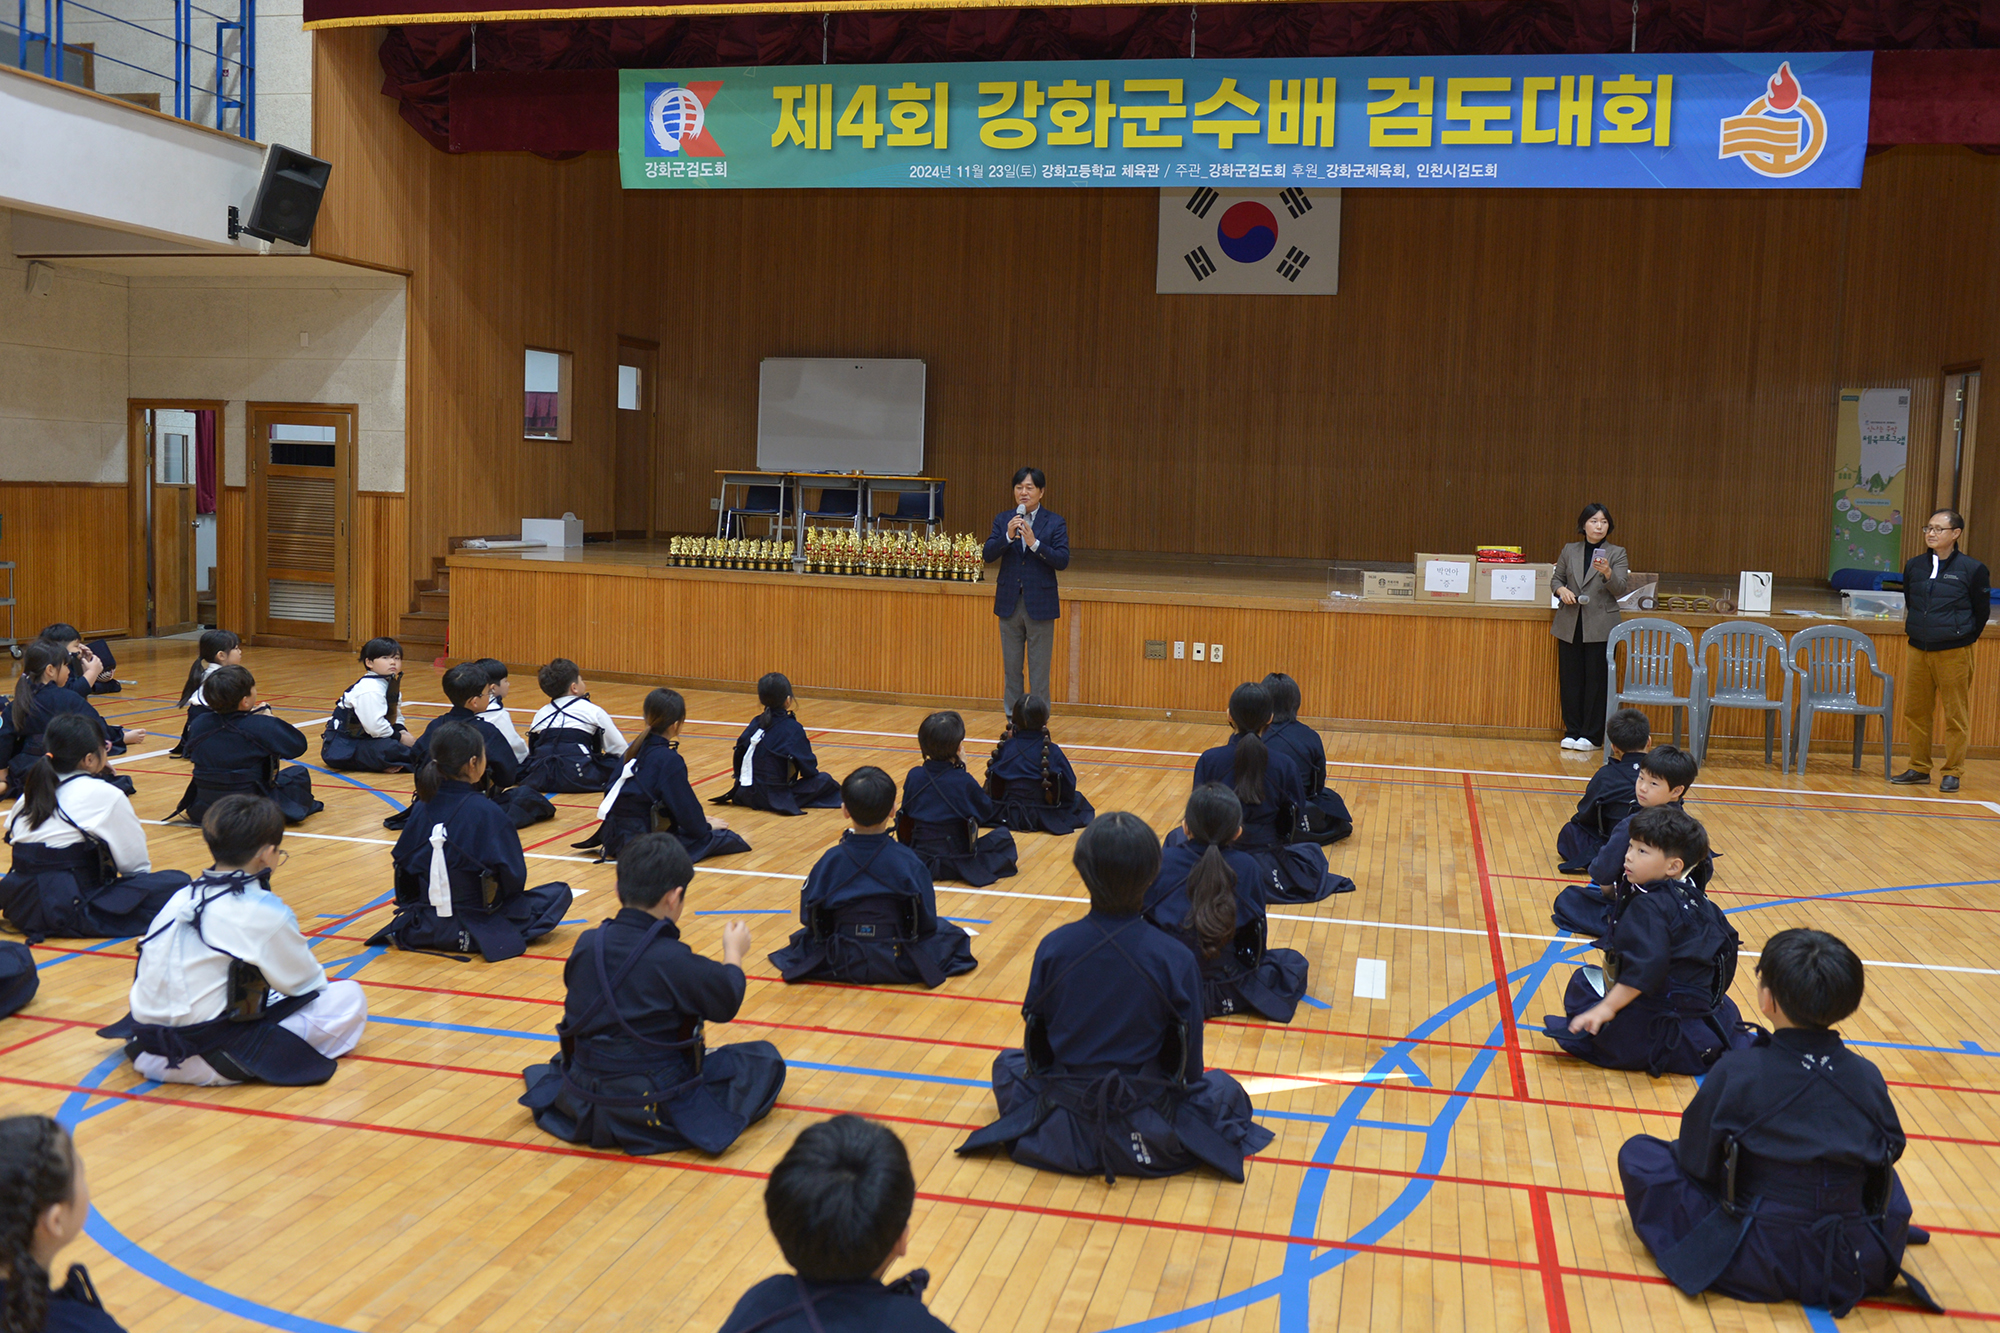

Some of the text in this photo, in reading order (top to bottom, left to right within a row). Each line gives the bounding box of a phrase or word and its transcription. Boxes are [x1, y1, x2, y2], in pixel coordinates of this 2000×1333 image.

[771, 74, 1674, 150] 제4회 강화군수배 검도대회
[645, 161, 728, 178] 강화군검도회
[909, 164, 951, 179] 2024년
[957, 164, 984, 179] 11월
[988, 163, 1037, 179] 23일(토)
[1041, 163, 1117, 179] 강화고등학교
[1121, 163, 1160, 179] 체육관
[1416, 163, 1498, 179] 인천시검도회
